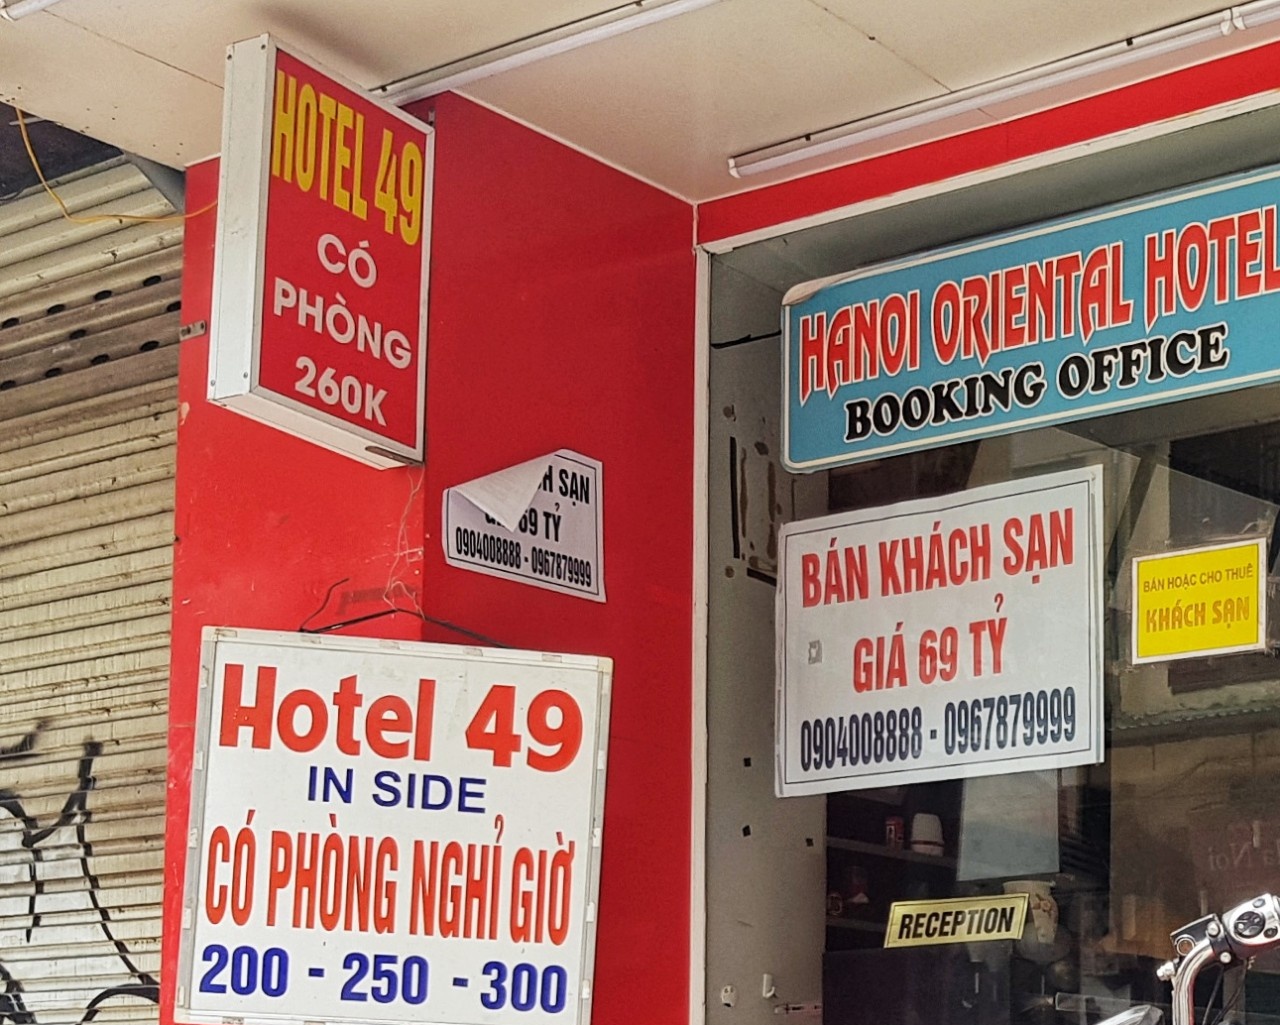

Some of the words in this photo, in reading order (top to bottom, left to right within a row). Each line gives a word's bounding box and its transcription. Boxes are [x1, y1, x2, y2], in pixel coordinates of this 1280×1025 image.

[272, 69, 368, 222] HOTEL
[374, 128, 423, 246] 49
[317, 233, 377, 289] CÓ
[274, 277, 412, 370] PHÒNG
[799, 289, 921, 407] HANOI
[931, 242, 1134, 368] ORIENTAL
[295, 356, 388, 427] 260K
[843, 362, 1047, 442] BOOKING
[1056, 322, 1229, 399] OFFICE
[543, 502, 562, 543] TỶ
[558, 468, 590, 506] SẠN
[455, 526, 521, 569] 0904008888
[531, 546, 592, 588] 0967879999
[801, 537, 870, 608] BÁN
[879, 521, 992, 597] KHÁCH
[1002, 507, 1075, 585] SẠN
[1143, 572, 1165, 593] BÁN
[1199, 570, 1223, 586] CHO
[1225, 563, 1254, 581] THUÊ
[852, 621, 908, 693] GIÁ
[918, 625, 959, 685] 69
[968, 592, 1008, 676] TỶ
[1146, 599, 1206, 633] KHÁCH
[1212, 596, 1250, 629] SẠN
[218, 662, 437, 762] Hotel
[464, 684, 584, 773] 49
[801, 705, 924, 773] 0904008888
[943, 686, 1077, 757] 0967879999
[307, 765, 354, 804] IN
[372, 769, 487, 815] SIDE
[205, 808, 257, 926] CÓ
[266, 812, 399, 935] PHÒNG
[409, 813, 504, 942] NGHỈ
[509, 831, 576, 947] GIỜ
[898, 906, 1016, 941] RECEPTION
[199, 944, 290, 998] 200
[340, 952, 429, 1005] 250
[480, 961, 568, 1014] 300
